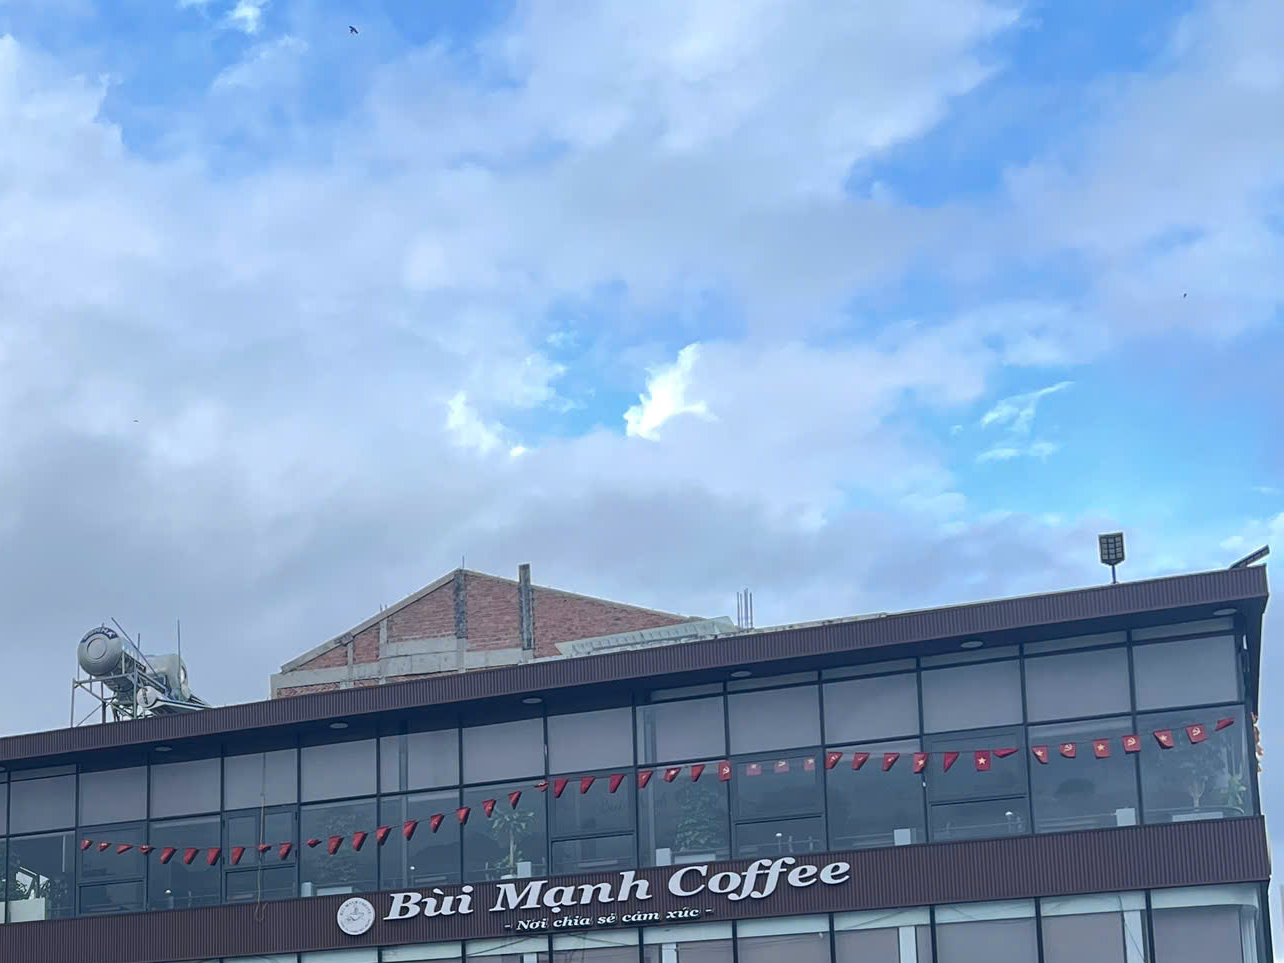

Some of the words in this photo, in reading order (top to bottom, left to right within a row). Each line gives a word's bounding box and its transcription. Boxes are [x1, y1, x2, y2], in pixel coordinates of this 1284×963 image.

[384, 885, 474, 920] Bùi
[490, 871, 652, 914] Mạnh
[668, 856, 851, 902] Coffee
[553, 914, 592, 929] chia
[622, 908, 661, 924] cảm
[666, 904, 700, 919] xúc
